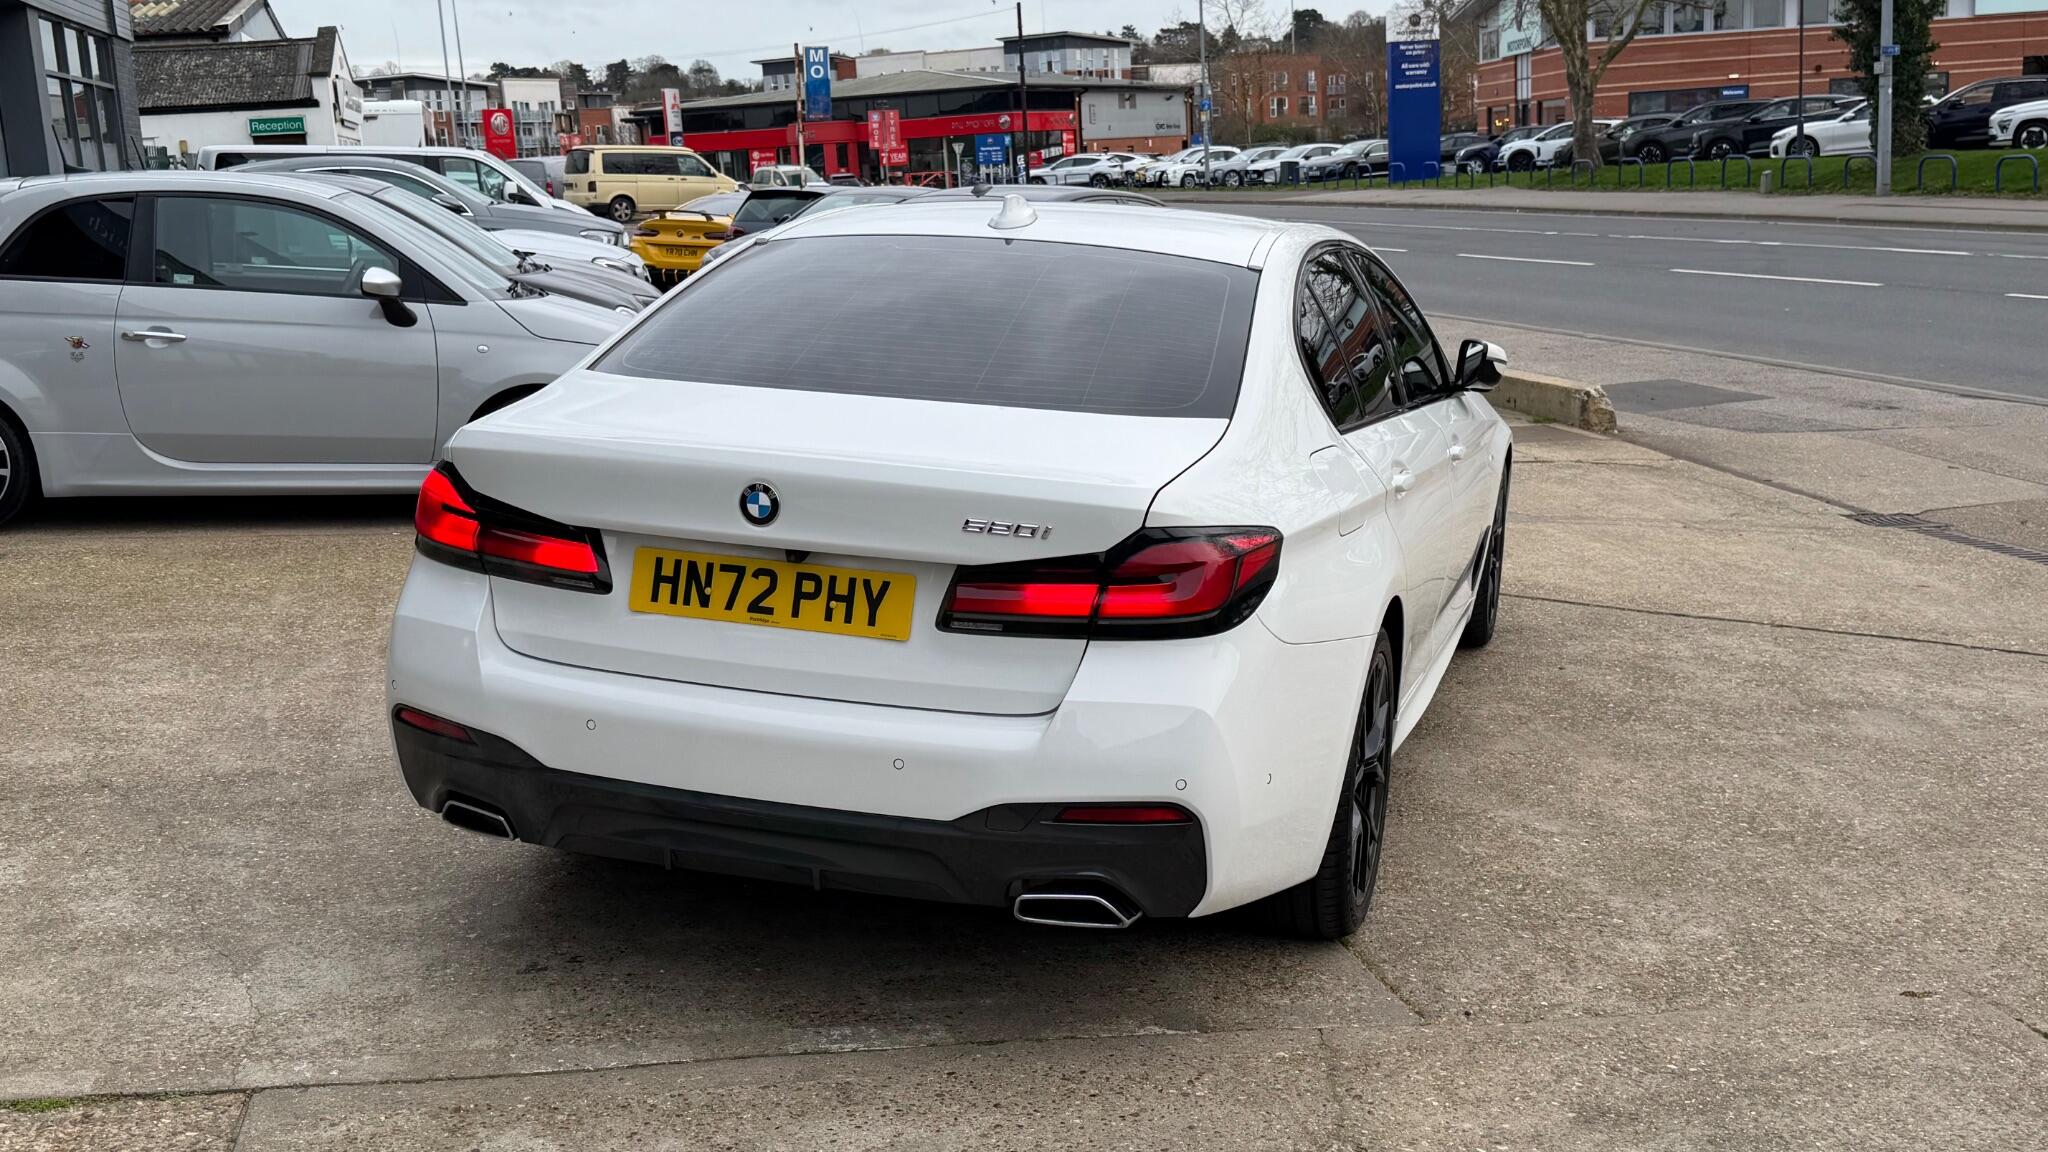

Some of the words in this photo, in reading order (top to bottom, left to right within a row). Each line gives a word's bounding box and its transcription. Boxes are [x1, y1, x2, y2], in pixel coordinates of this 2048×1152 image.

[251, 120, 303, 132] Reception
[650, 556, 779, 616] HN72
[790, 571, 891, 627] PHY
